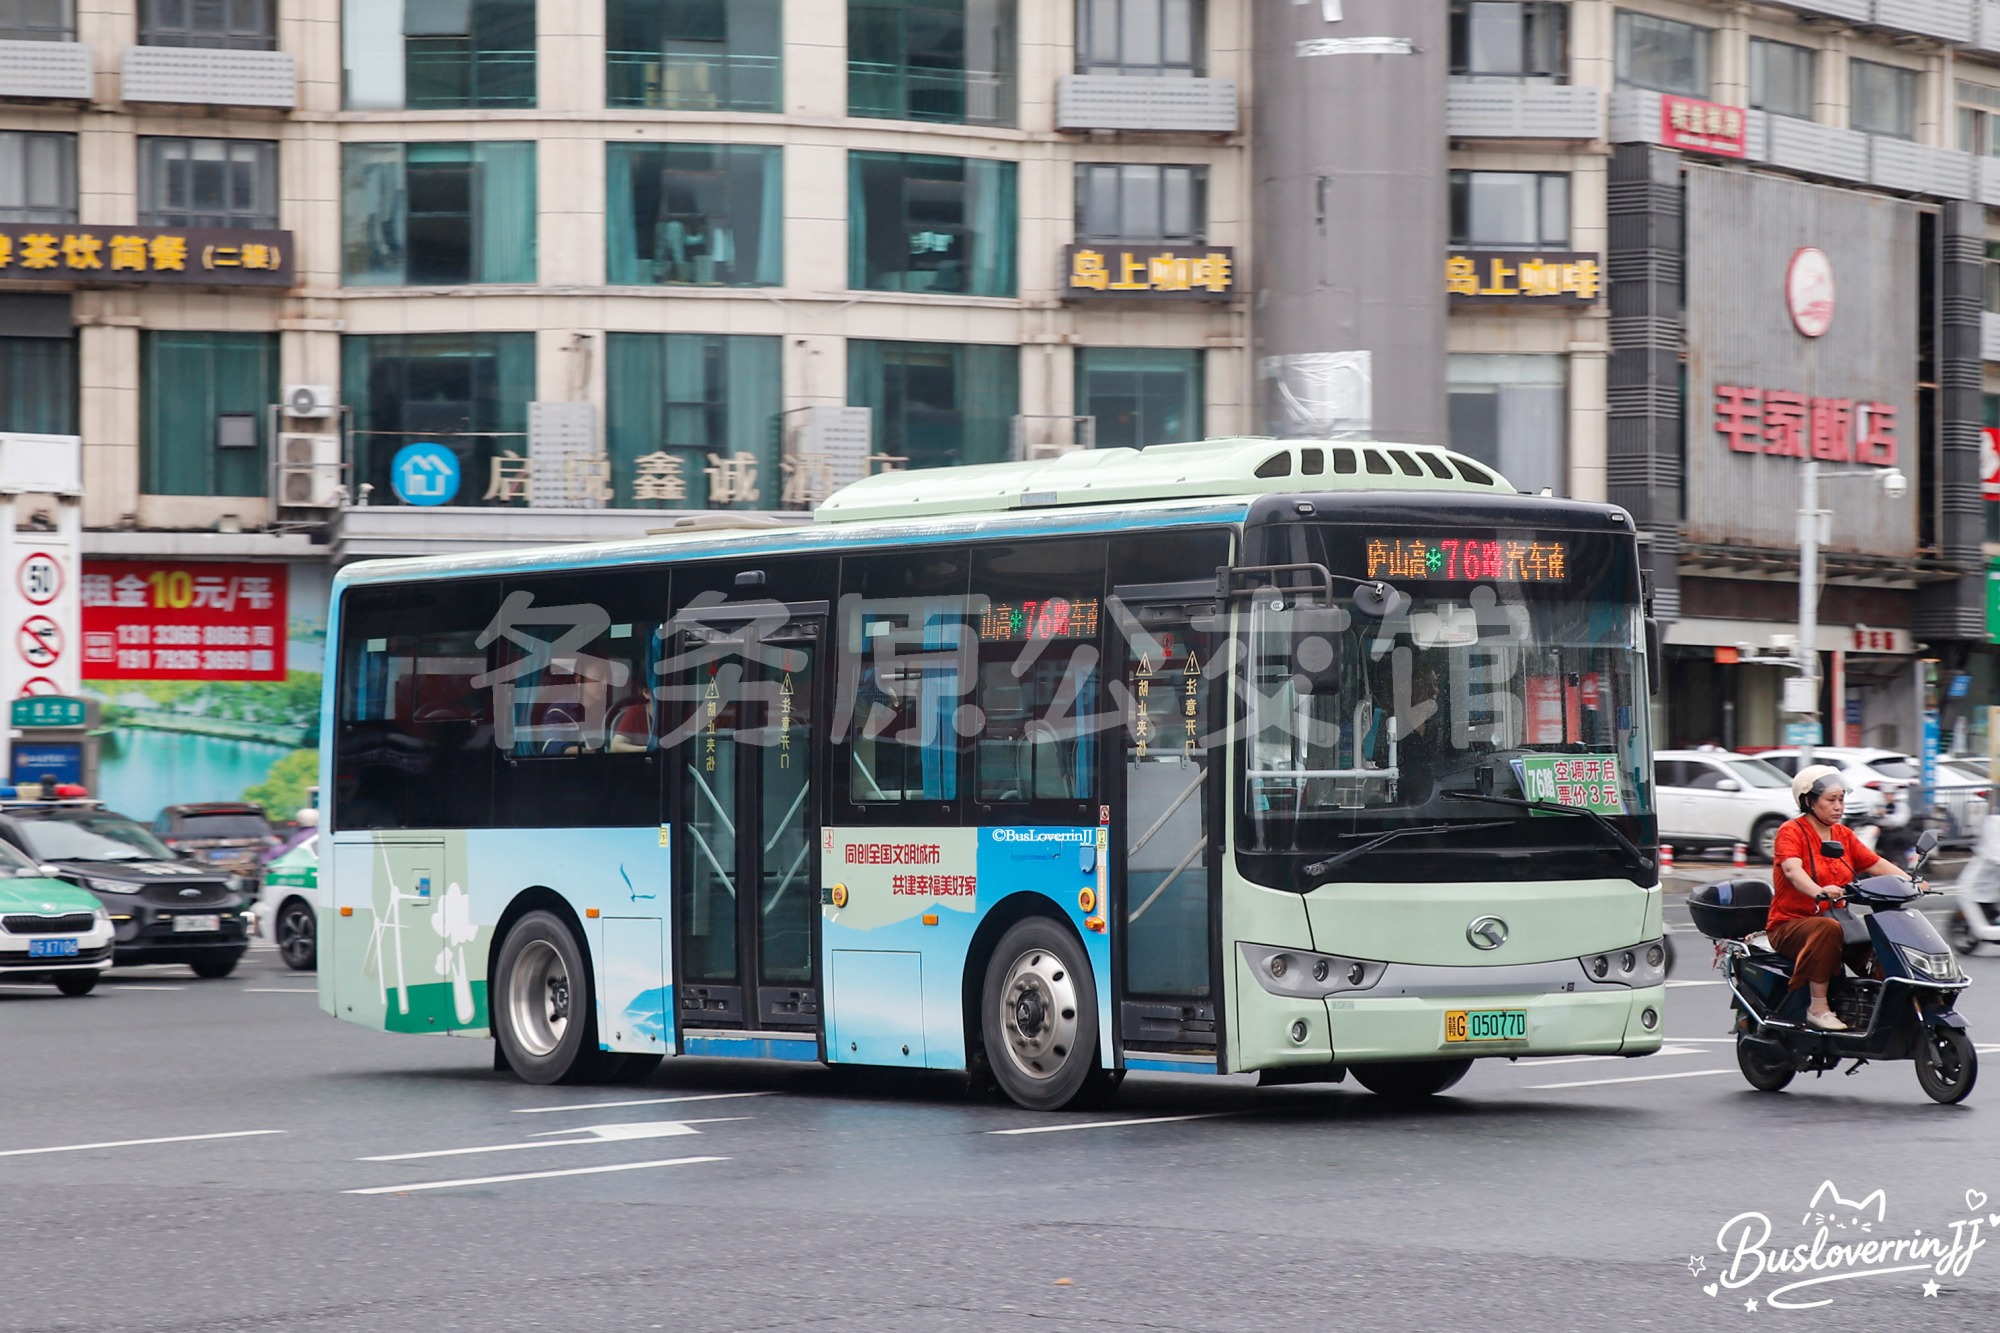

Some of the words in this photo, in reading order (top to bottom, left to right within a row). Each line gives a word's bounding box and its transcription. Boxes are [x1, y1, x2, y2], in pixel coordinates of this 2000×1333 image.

[1070, 249, 1233, 292] 岛上咖啡
[1445, 255, 1600, 299] 岛上咖啡
[1367, 539, 1428, 579] 庐山高
[1440, 538, 1504, 580] 76路
[1023, 599, 1071, 639] 76路
[1527, 767, 1556, 799] 76路
[1554, 759, 1617, 782] 空调开启
[1557, 783, 1619, 807] 票价3元
[844, 843, 941, 865] 同创全国文明城市
[892, 873, 977, 897] 共建幸福美好家
